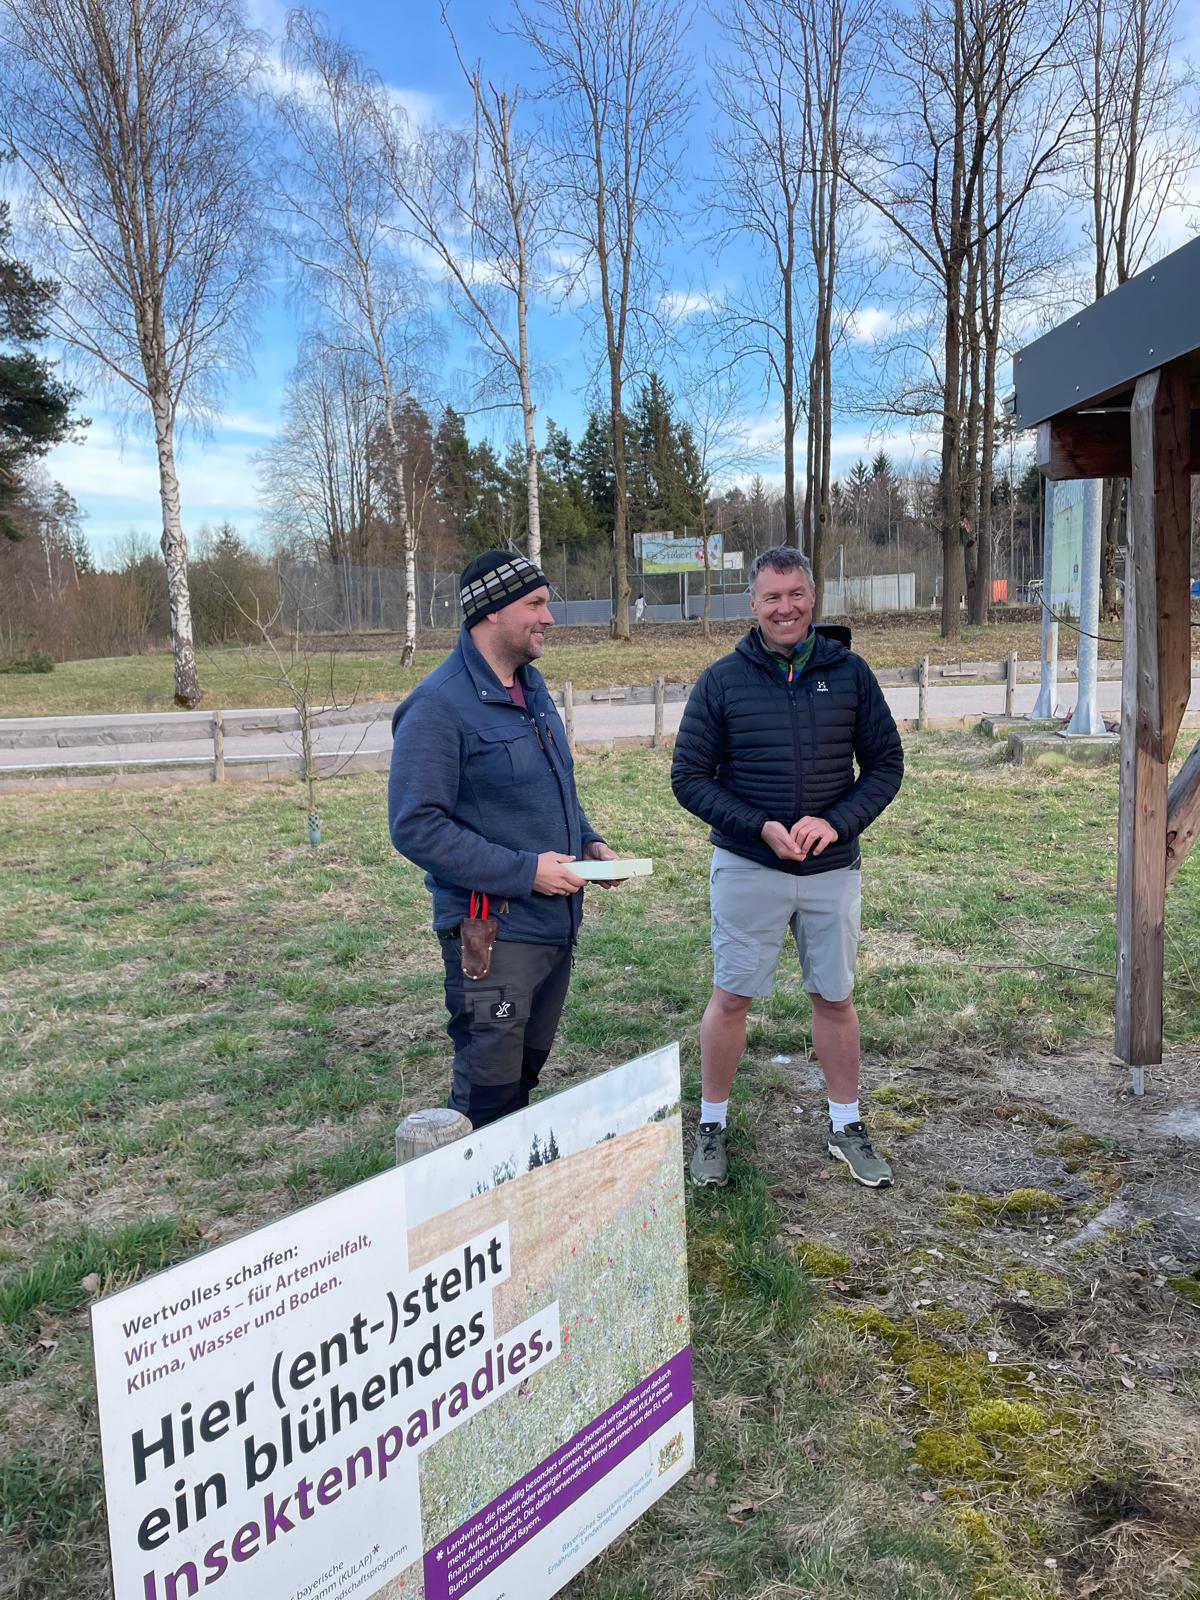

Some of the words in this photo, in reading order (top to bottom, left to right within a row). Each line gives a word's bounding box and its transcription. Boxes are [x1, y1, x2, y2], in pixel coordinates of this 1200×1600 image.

[122, 1283, 221, 1338] Wertvolles
[226, 1245, 298, 1290] schaffen:
[124, 1341, 157, 1366] Wir
[162, 1324, 193, 1348] tun
[197, 1305, 231, 1330] was
[248, 1284, 272, 1306] für
[275, 1234, 372, 1292] Artenvielfalt,
[126, 1358, 186, 1395] Klima,
[189, 1322, 250, 1362] Wasser
[254, 1299, 285, 1328] und
[289, 1276, 342, 1311] Boden.
[131, 1381, 254, 1486] Hier
[271, 1236, 503, 1409] (ent-)steht
[138, 1472, 228, 1551] ein
[244, 1311, 485, 1491] blühendes
[143, 1328, 553, 1600] Insektenparadies.
[446, 1522, 484, 1555] Landwirte,
[484, 1511, 496, 1525] die
[496, 1488, 525, 1515] freiwillig
[525, 1461, 558, 1492] besonders
[558, 1419, 607, 1466] umweltschonend
[607, 1394, 640, 1425] wirtschaften
[640, 1384, 651, 1398] und
[651, 1369, 672, 1389] dadurch
[447, 1548, 467, 1569] mehr
[468, 1523, 499, 1553] Aufwand
[499, 1507, 521, 1526] haben
[521, 1492, 537, 1509] oder
[537, 1471, 561, 1496] weniger
[562, 1455, 583, 1475] ernten,
[583, 1428, 616, 1458] bekommen
[615, 1415, 628, 1431] über
[628, 1408, 639, 1420] das
[638, 1392, 656, 1412] KULAP
[448, 1545, 488, 1582] finanziellen
[489, 1517, 522, 1549] Ausgleich.
[523, 1506, 535, 1520] Die
[535, 1492, 552, 1511] dafür
[552, 1460, 591, 1495] verwendeten
[591, 1445, 608, 1465] Mittel
[608, 1424, 633, 1450] stammen
[633, 1416, 644, 1428] von
[643, 1408, 653, 1419] der
[296, 1561, 344, 1600] bayerische
[334, 1543, 408, 1600] ndschaftsprogramm
[448, 1575, 468, 1596] Bund
[469, 1562, 483, 1578] und
[484, 1548, 500, 1566] vom
[500, 1536, 517, 1553] Land
[517, 1515, 542, 1540] Bayern.
